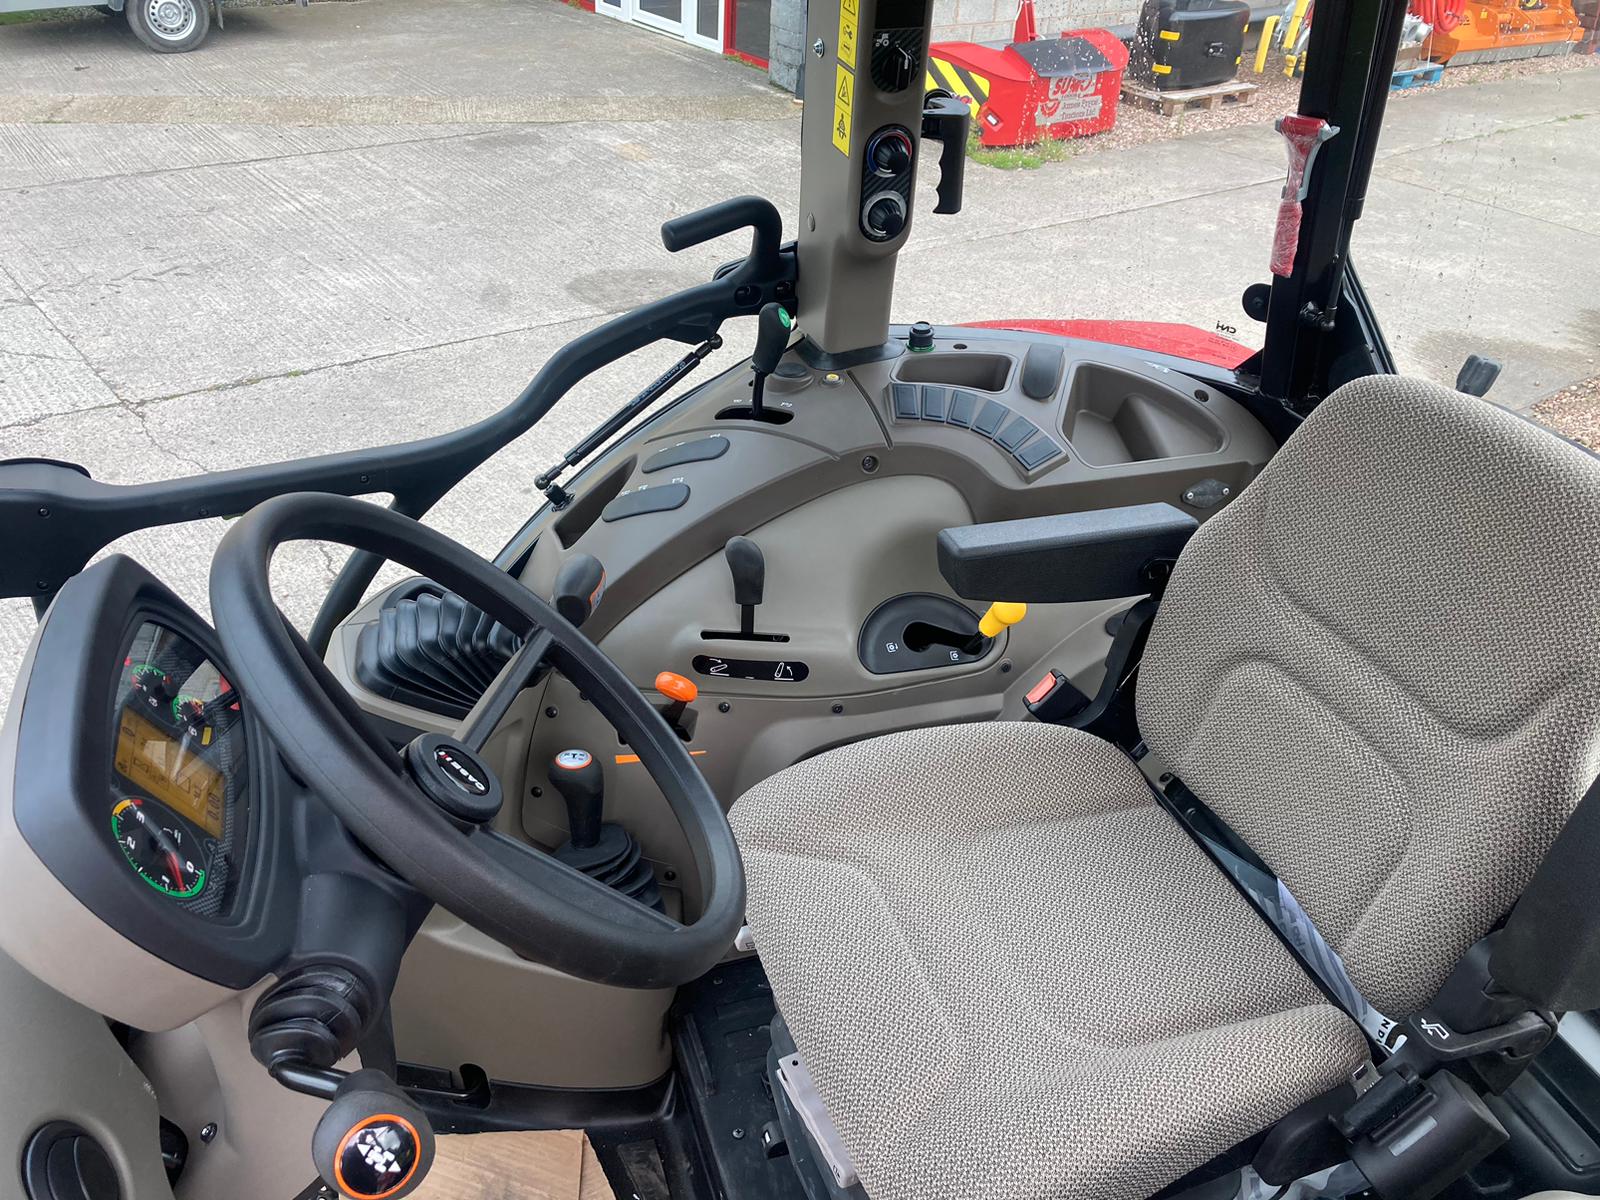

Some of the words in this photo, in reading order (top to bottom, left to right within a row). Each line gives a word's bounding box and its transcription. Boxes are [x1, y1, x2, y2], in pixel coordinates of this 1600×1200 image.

[450, 761, 485, 790] CASE
[136, 810, 145, 824] 3
[126, 836, 136, 850] 2
[186, 861, 195, 873] 0
[162, 874, 171, 883] 1
